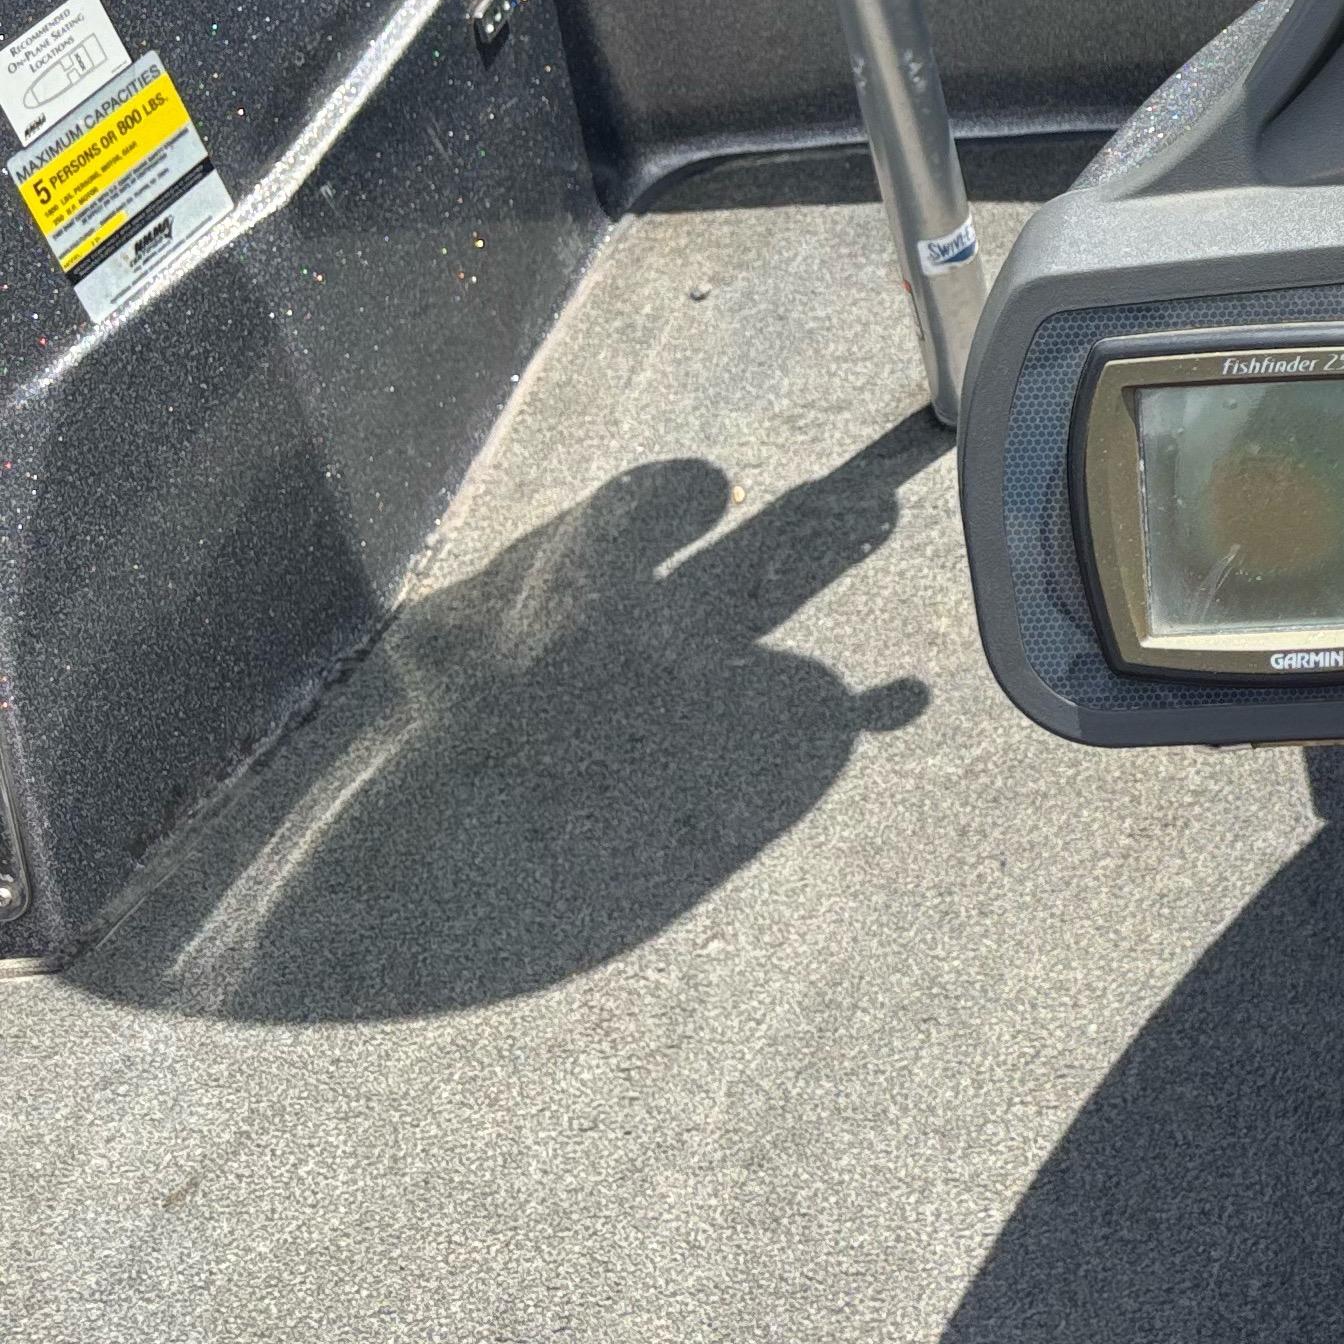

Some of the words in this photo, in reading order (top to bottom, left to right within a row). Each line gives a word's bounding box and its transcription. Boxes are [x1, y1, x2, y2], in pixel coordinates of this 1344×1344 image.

[10, 8, 71, 58] RECOMMENDED
[51, 12, 85, 41] SEATING
[29, 35, 75, 74] LOCATIONS
[16, 123, 84, 184] MAXIMUM
[84, 64, 161, 130] CAPACITIES
[32, 178, 52, 205] 5
[50, 142, 102, 190] PERSONS
[100, 130, 118, 150] OR
[117, 108, 143, 136] 800
[1270, 650, 1344, 670] GARMIN
